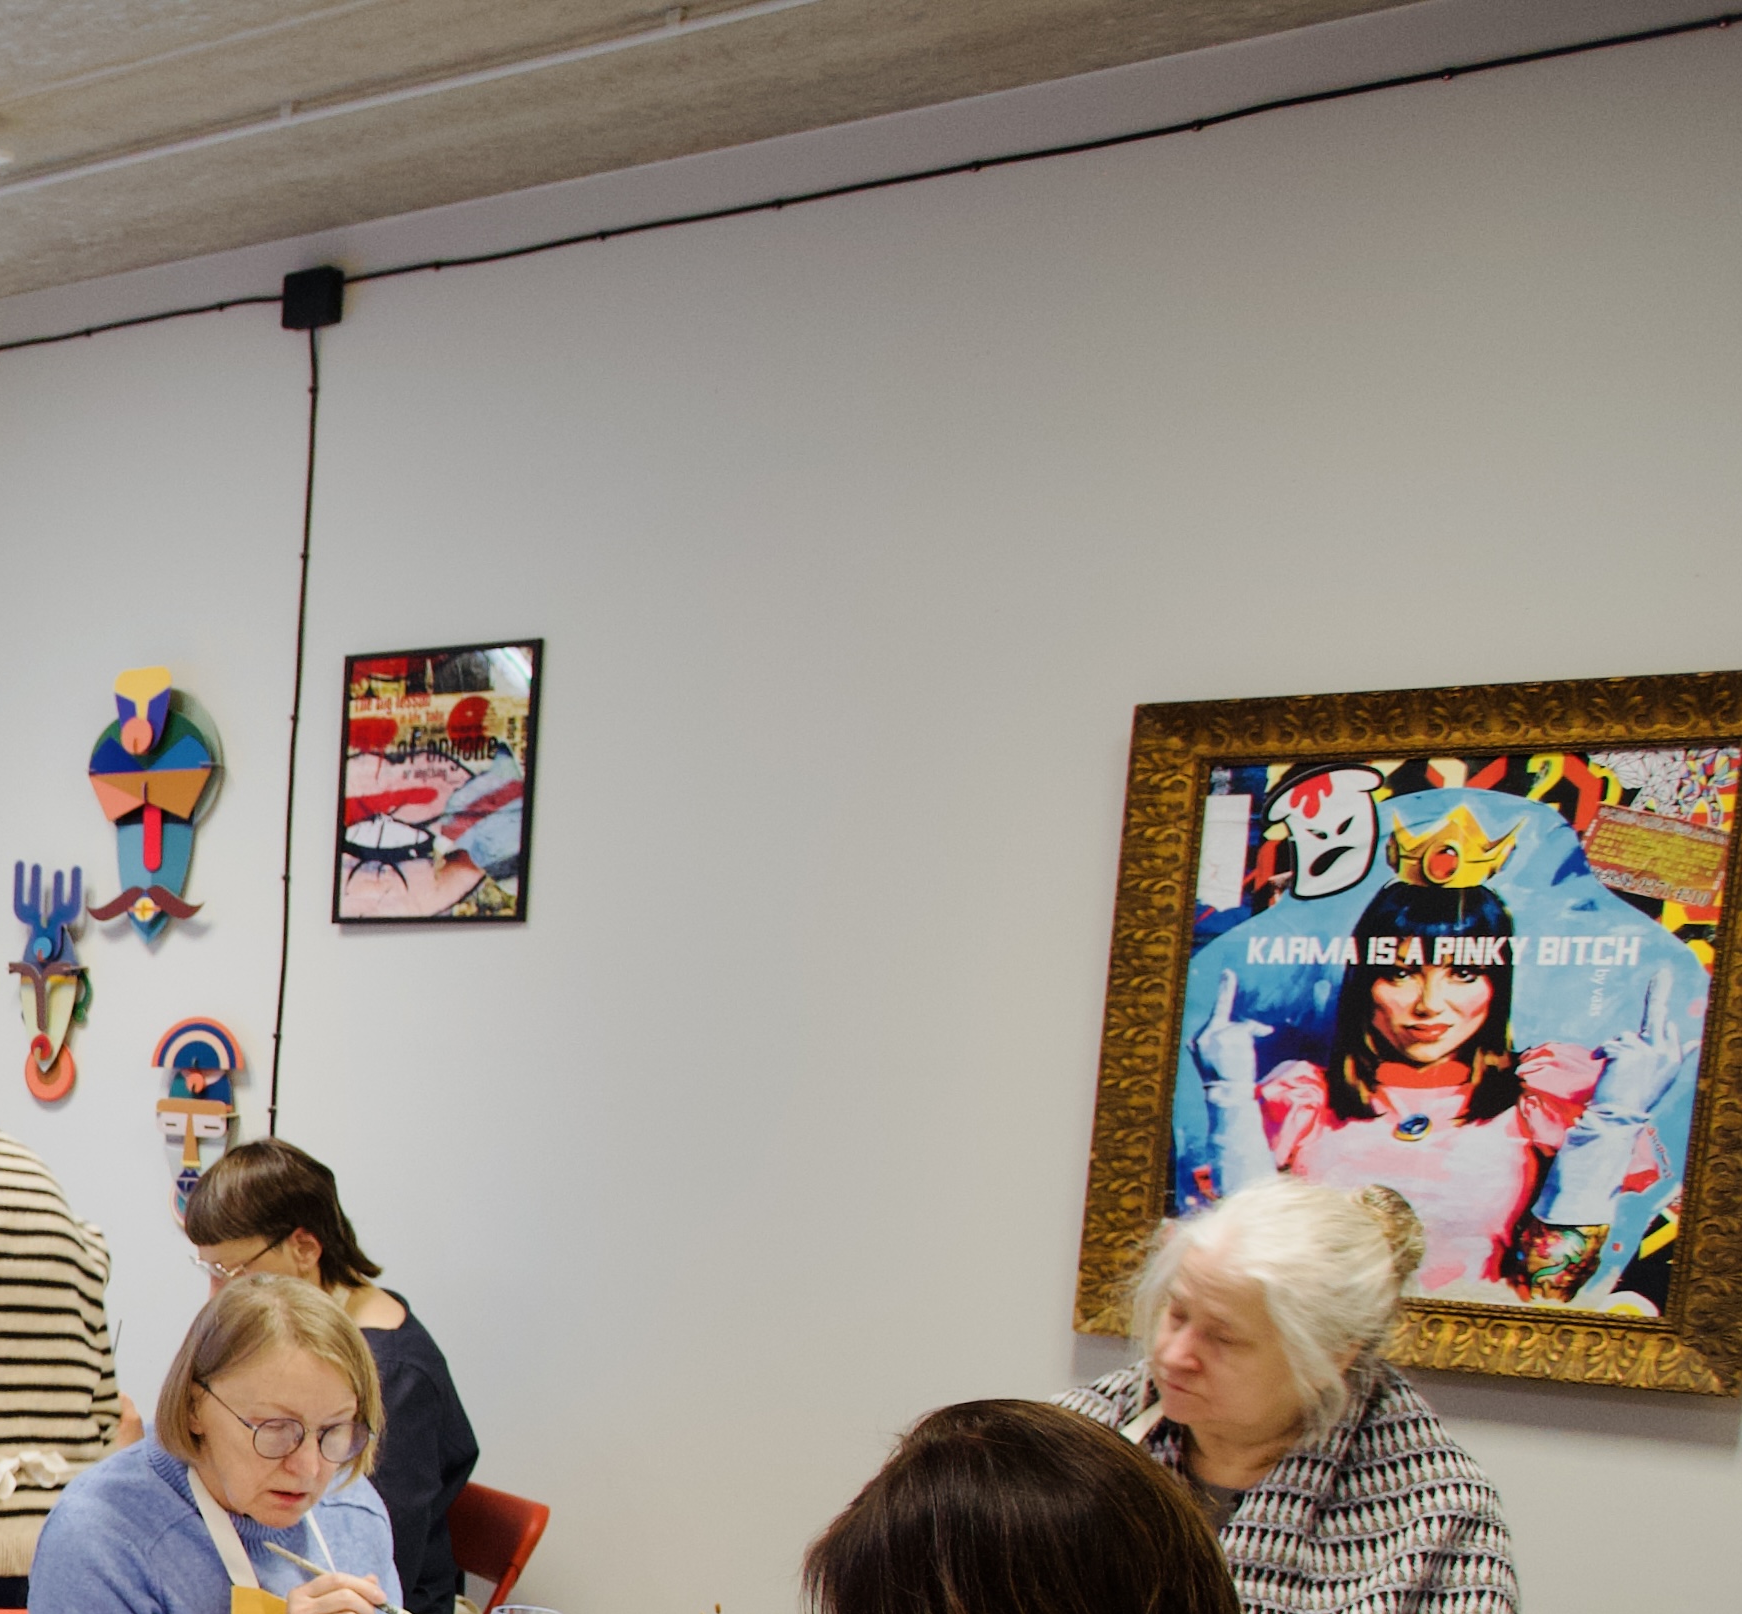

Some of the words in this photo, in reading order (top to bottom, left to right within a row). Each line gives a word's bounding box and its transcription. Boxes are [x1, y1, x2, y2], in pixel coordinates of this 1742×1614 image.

[427, 735, 498, 771] anyone
[1247, 936, 1359, 965] KARMA
[1367, 936, 1399, 965] IS
[1403, 936, 1425, 965] A
[1433, 936, 1528, 966] PINKY
[1536, 936, 1640, 966] BITCH
